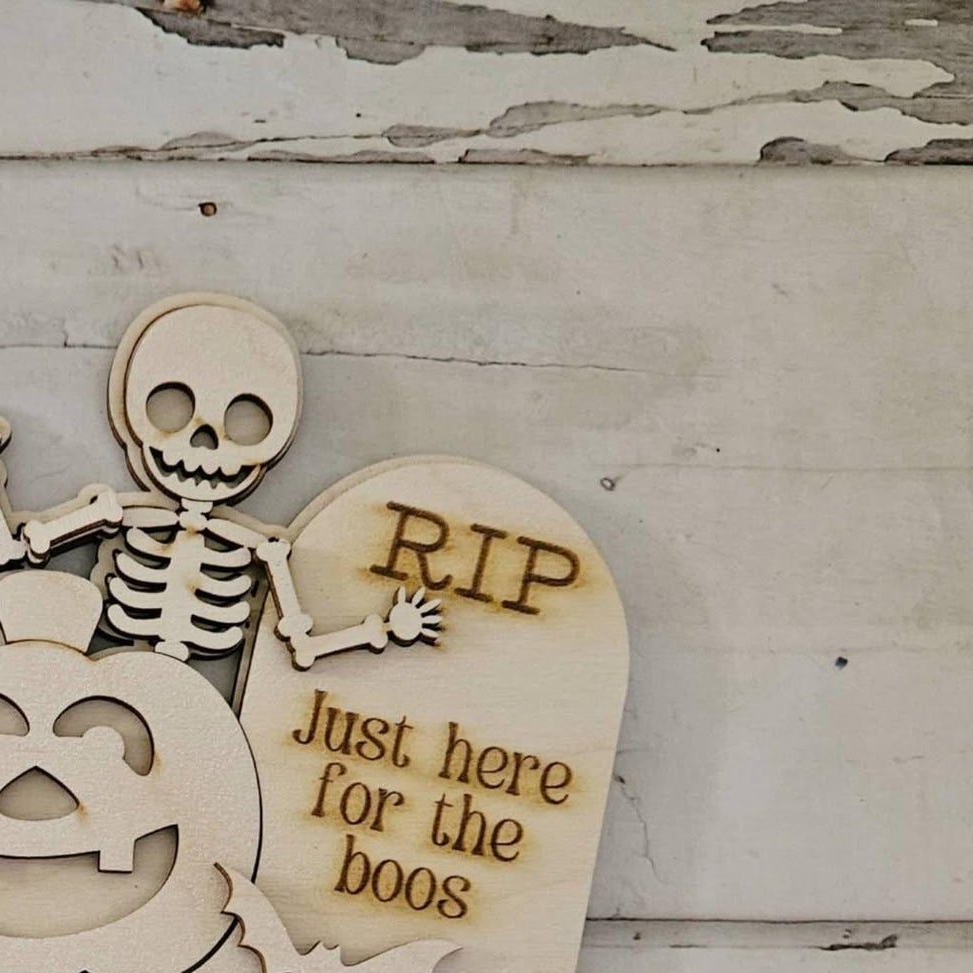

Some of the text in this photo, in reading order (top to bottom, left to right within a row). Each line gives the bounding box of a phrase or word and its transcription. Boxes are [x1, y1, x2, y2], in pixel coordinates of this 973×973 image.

[369, 501, 581, 615] RIP
[292, 689, 573, 805] Just here
[311, 762, 524, 862] for the
[334, 834, 471, 919] boos
